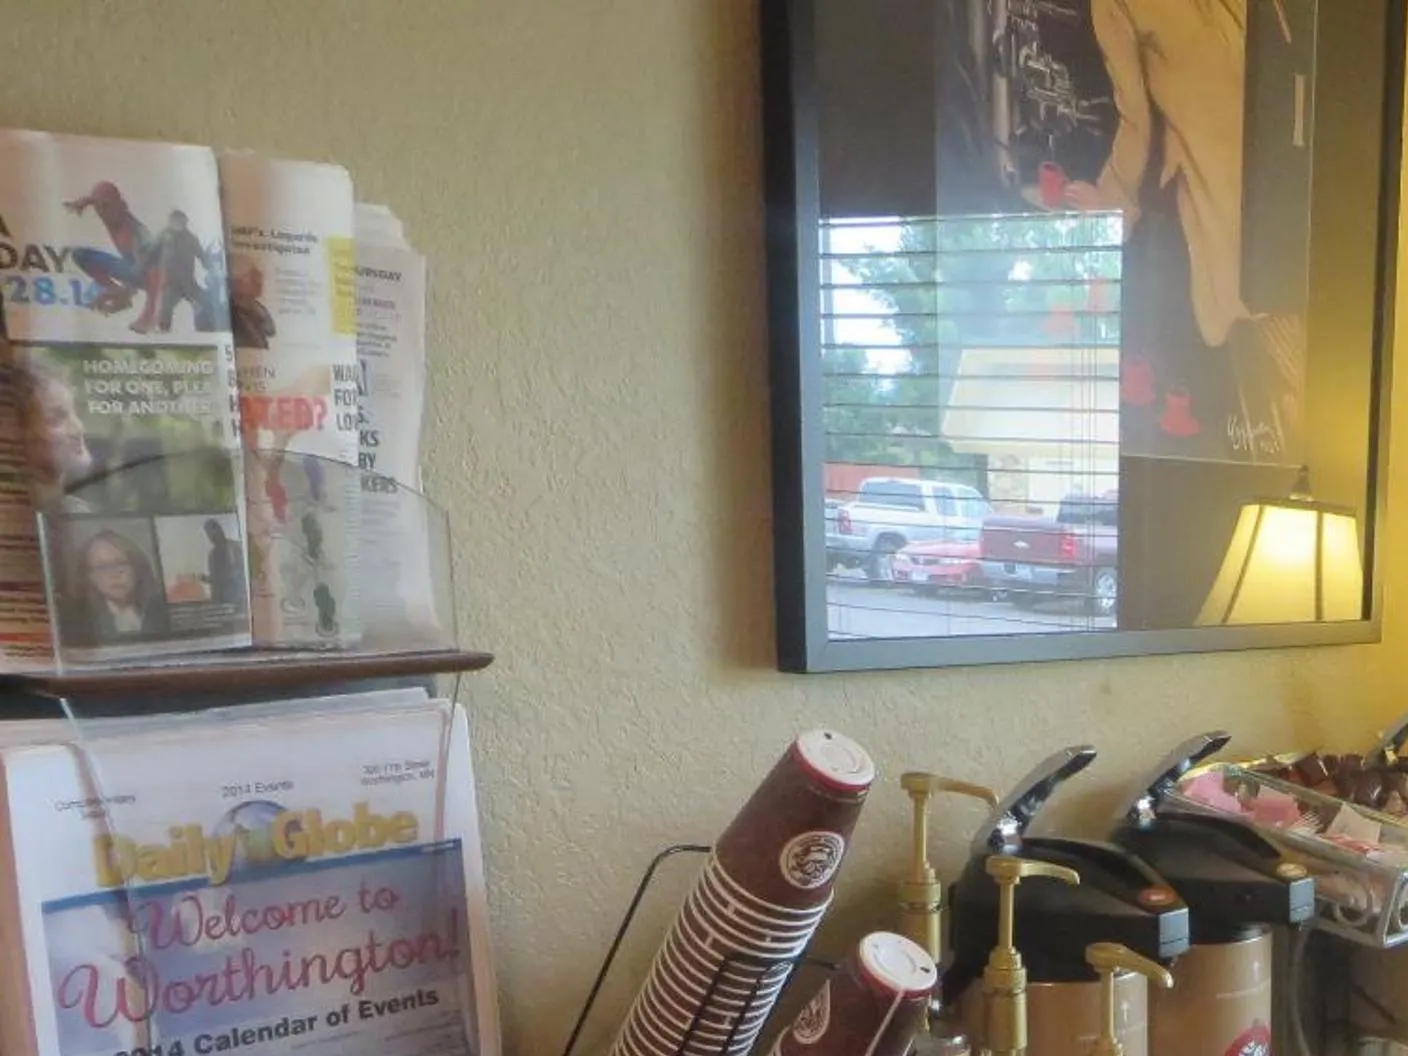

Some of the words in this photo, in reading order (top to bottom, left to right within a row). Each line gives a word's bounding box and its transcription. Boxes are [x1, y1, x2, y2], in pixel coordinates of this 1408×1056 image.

[82, 359, 214, 374] HOMECOMING
[85, 380, 122, 395] FOR
[88, 400, 123, 415] FOR
[92, 824, 237, 887] Daily
[272, 801, 420, 861] Globe
[126, 892, 345, 948] Welcome
[359, 880, 400, 915] to
[58, 907, 461, 1029] Worthington!
[194, 1011, 318, 1055] Calendar
[325, 1001, 350, 1026] of
[358, 988, 440, 1020] Events
